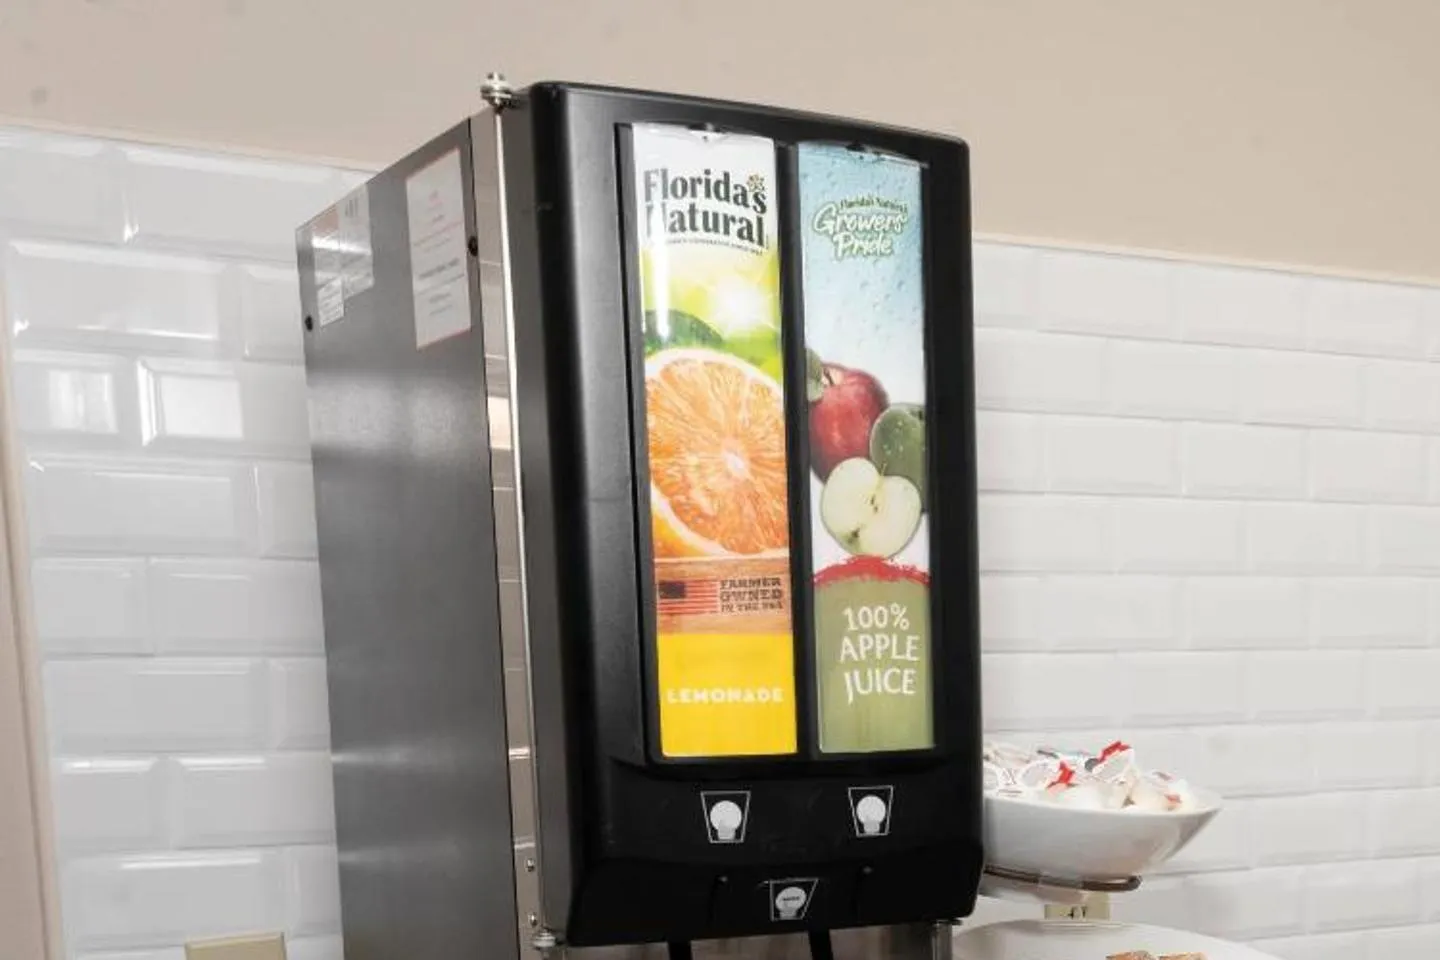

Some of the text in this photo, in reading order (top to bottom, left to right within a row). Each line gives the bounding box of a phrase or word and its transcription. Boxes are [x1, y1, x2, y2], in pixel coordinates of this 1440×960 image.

[814, 203, 908, 234] Growers
[833, 231, 893, 258] Pride
[720, 577, 781, 591] FARMER
[720, 589, 783, 602] OWNED
[842, 602, 910, 632] 100%
[840, 633, 920, 664] APPLE
[667, 688, 784, 704] LEMONADE
[844, 667, 917, 705] JUICE
